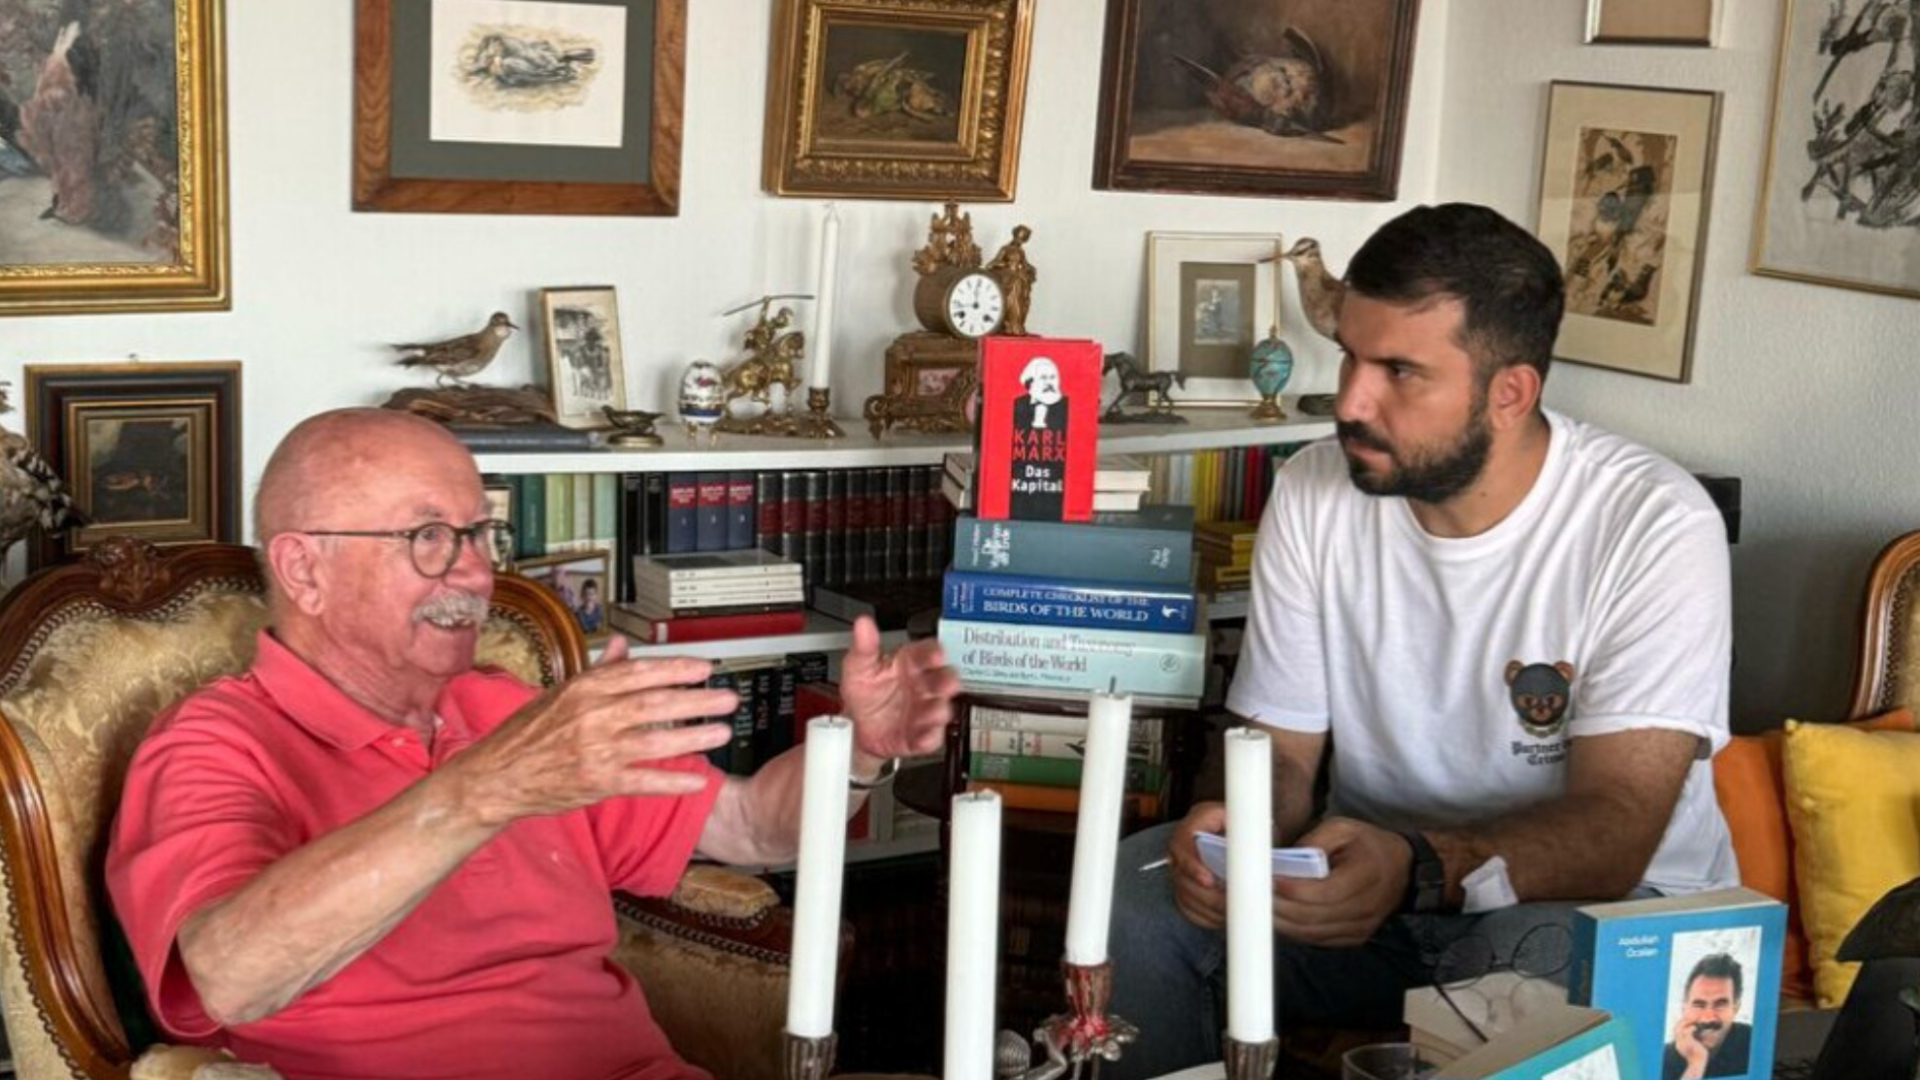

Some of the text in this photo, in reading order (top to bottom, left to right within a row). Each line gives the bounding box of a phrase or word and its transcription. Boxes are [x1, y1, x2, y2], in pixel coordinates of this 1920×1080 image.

[1014, 429, 1064, 446] KARL
[1013, 446, 1065, 461] MARX
[1025, 464, 1050, 478] Das
[1012, 478, 1063, 494] Kapital
[983, 587, 1042, 600] COMPLETE
[1044, 590, 1104, 604] CHECKLIST
[983, 600, 1149, 622] BIRDS OF THE WORLD
[963, 626, 1040, 650] Distribution
[962, 650, 1087, 672] of Birds of the World
